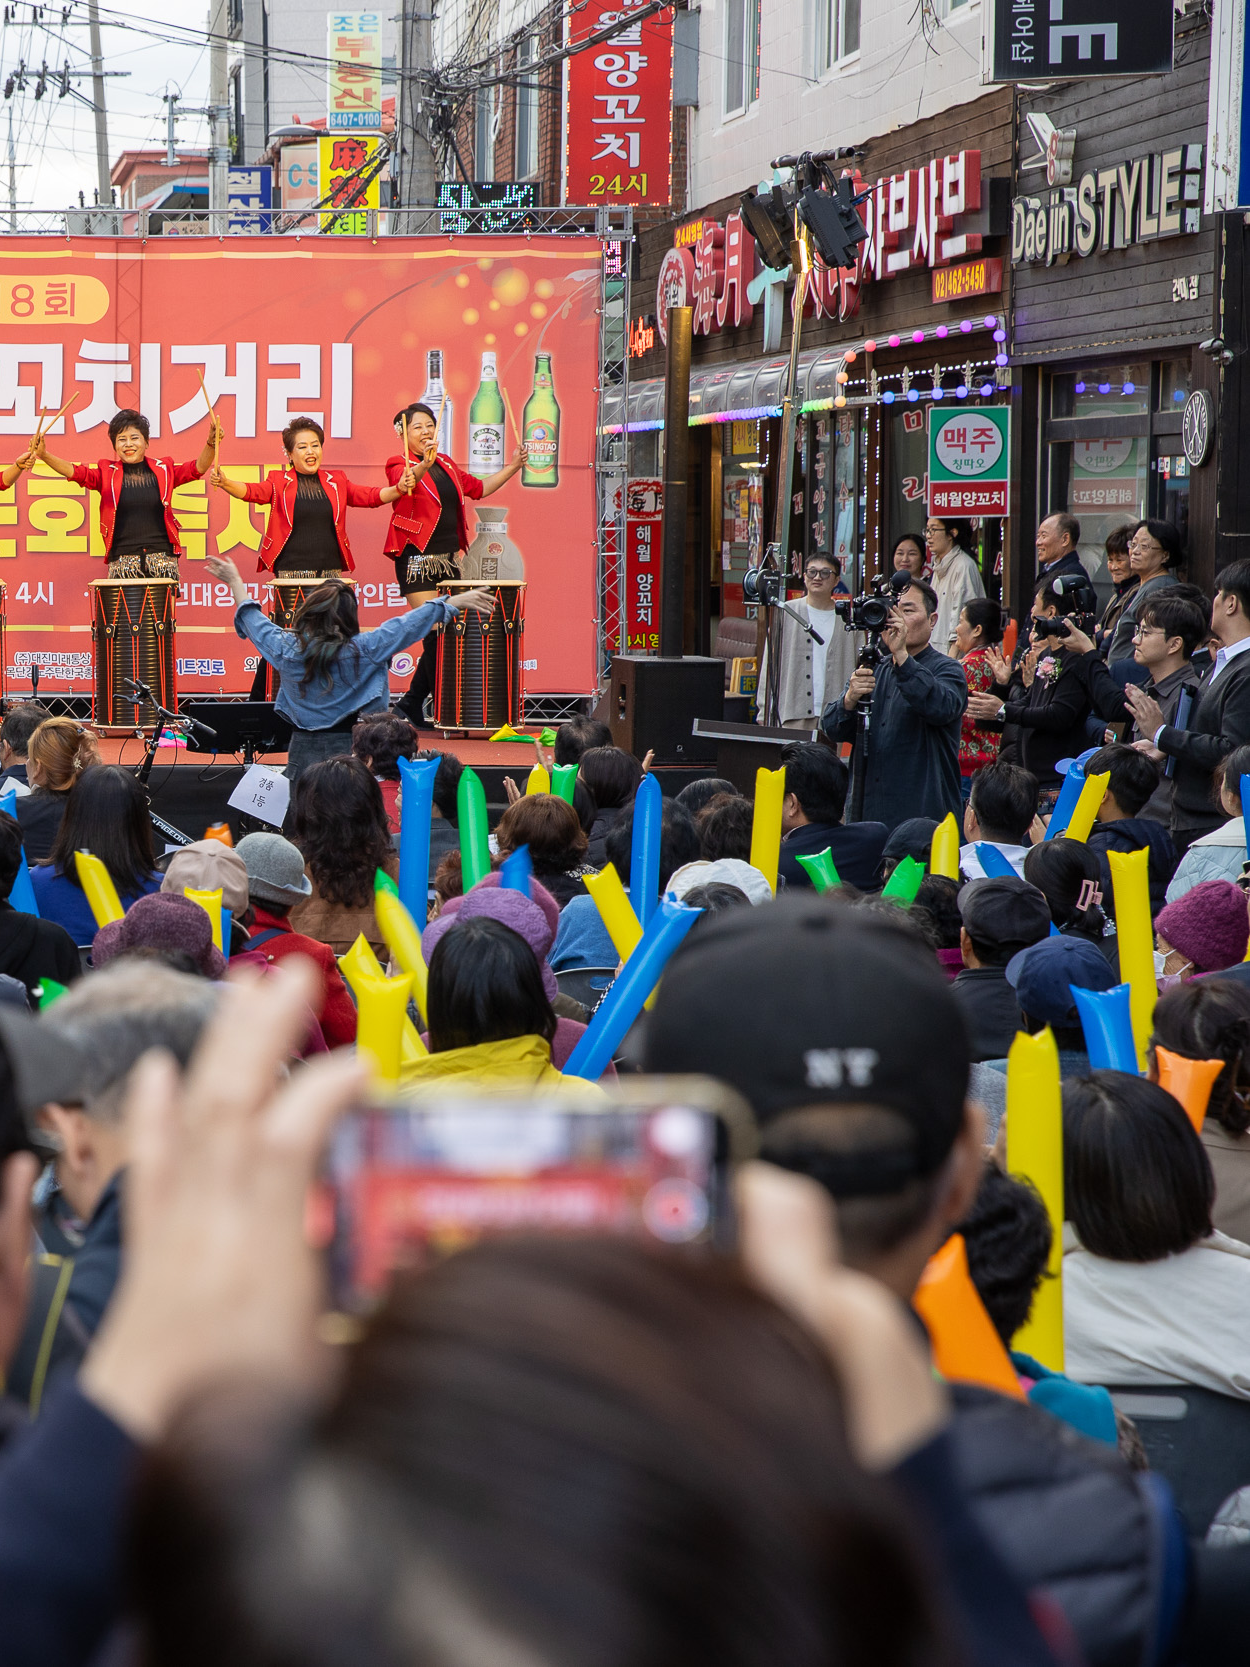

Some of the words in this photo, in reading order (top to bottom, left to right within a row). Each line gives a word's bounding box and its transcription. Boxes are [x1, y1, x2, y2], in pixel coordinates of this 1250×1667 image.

[333, 14, 379, 33] 조은
[333, 37, 377, 110] 부동산
[330, 114, 380, 127] 6407-0100
[589, 173, 648, 197] 24시
[1075, 145, 1184, 258] STYLE
[935, 263, 986, 299] 02)462-5450
[523, 442, 558, 451] TSINGTAO
[943, 427, 996, 454] 맥주
[952, 458, 985, 469] 칭따오
[933, 490, 1005, 508] 해월양꼬치
[635, 524, 652, 563] 해월
[15, 582, 54, 606] 4시
[635, 573, 654, 626] 양꼬치
[14, 652, 92, 666] (주)대진미래통상
[258, 777, 274, 792] 경품
[251, 792, 266, 808] 1등
